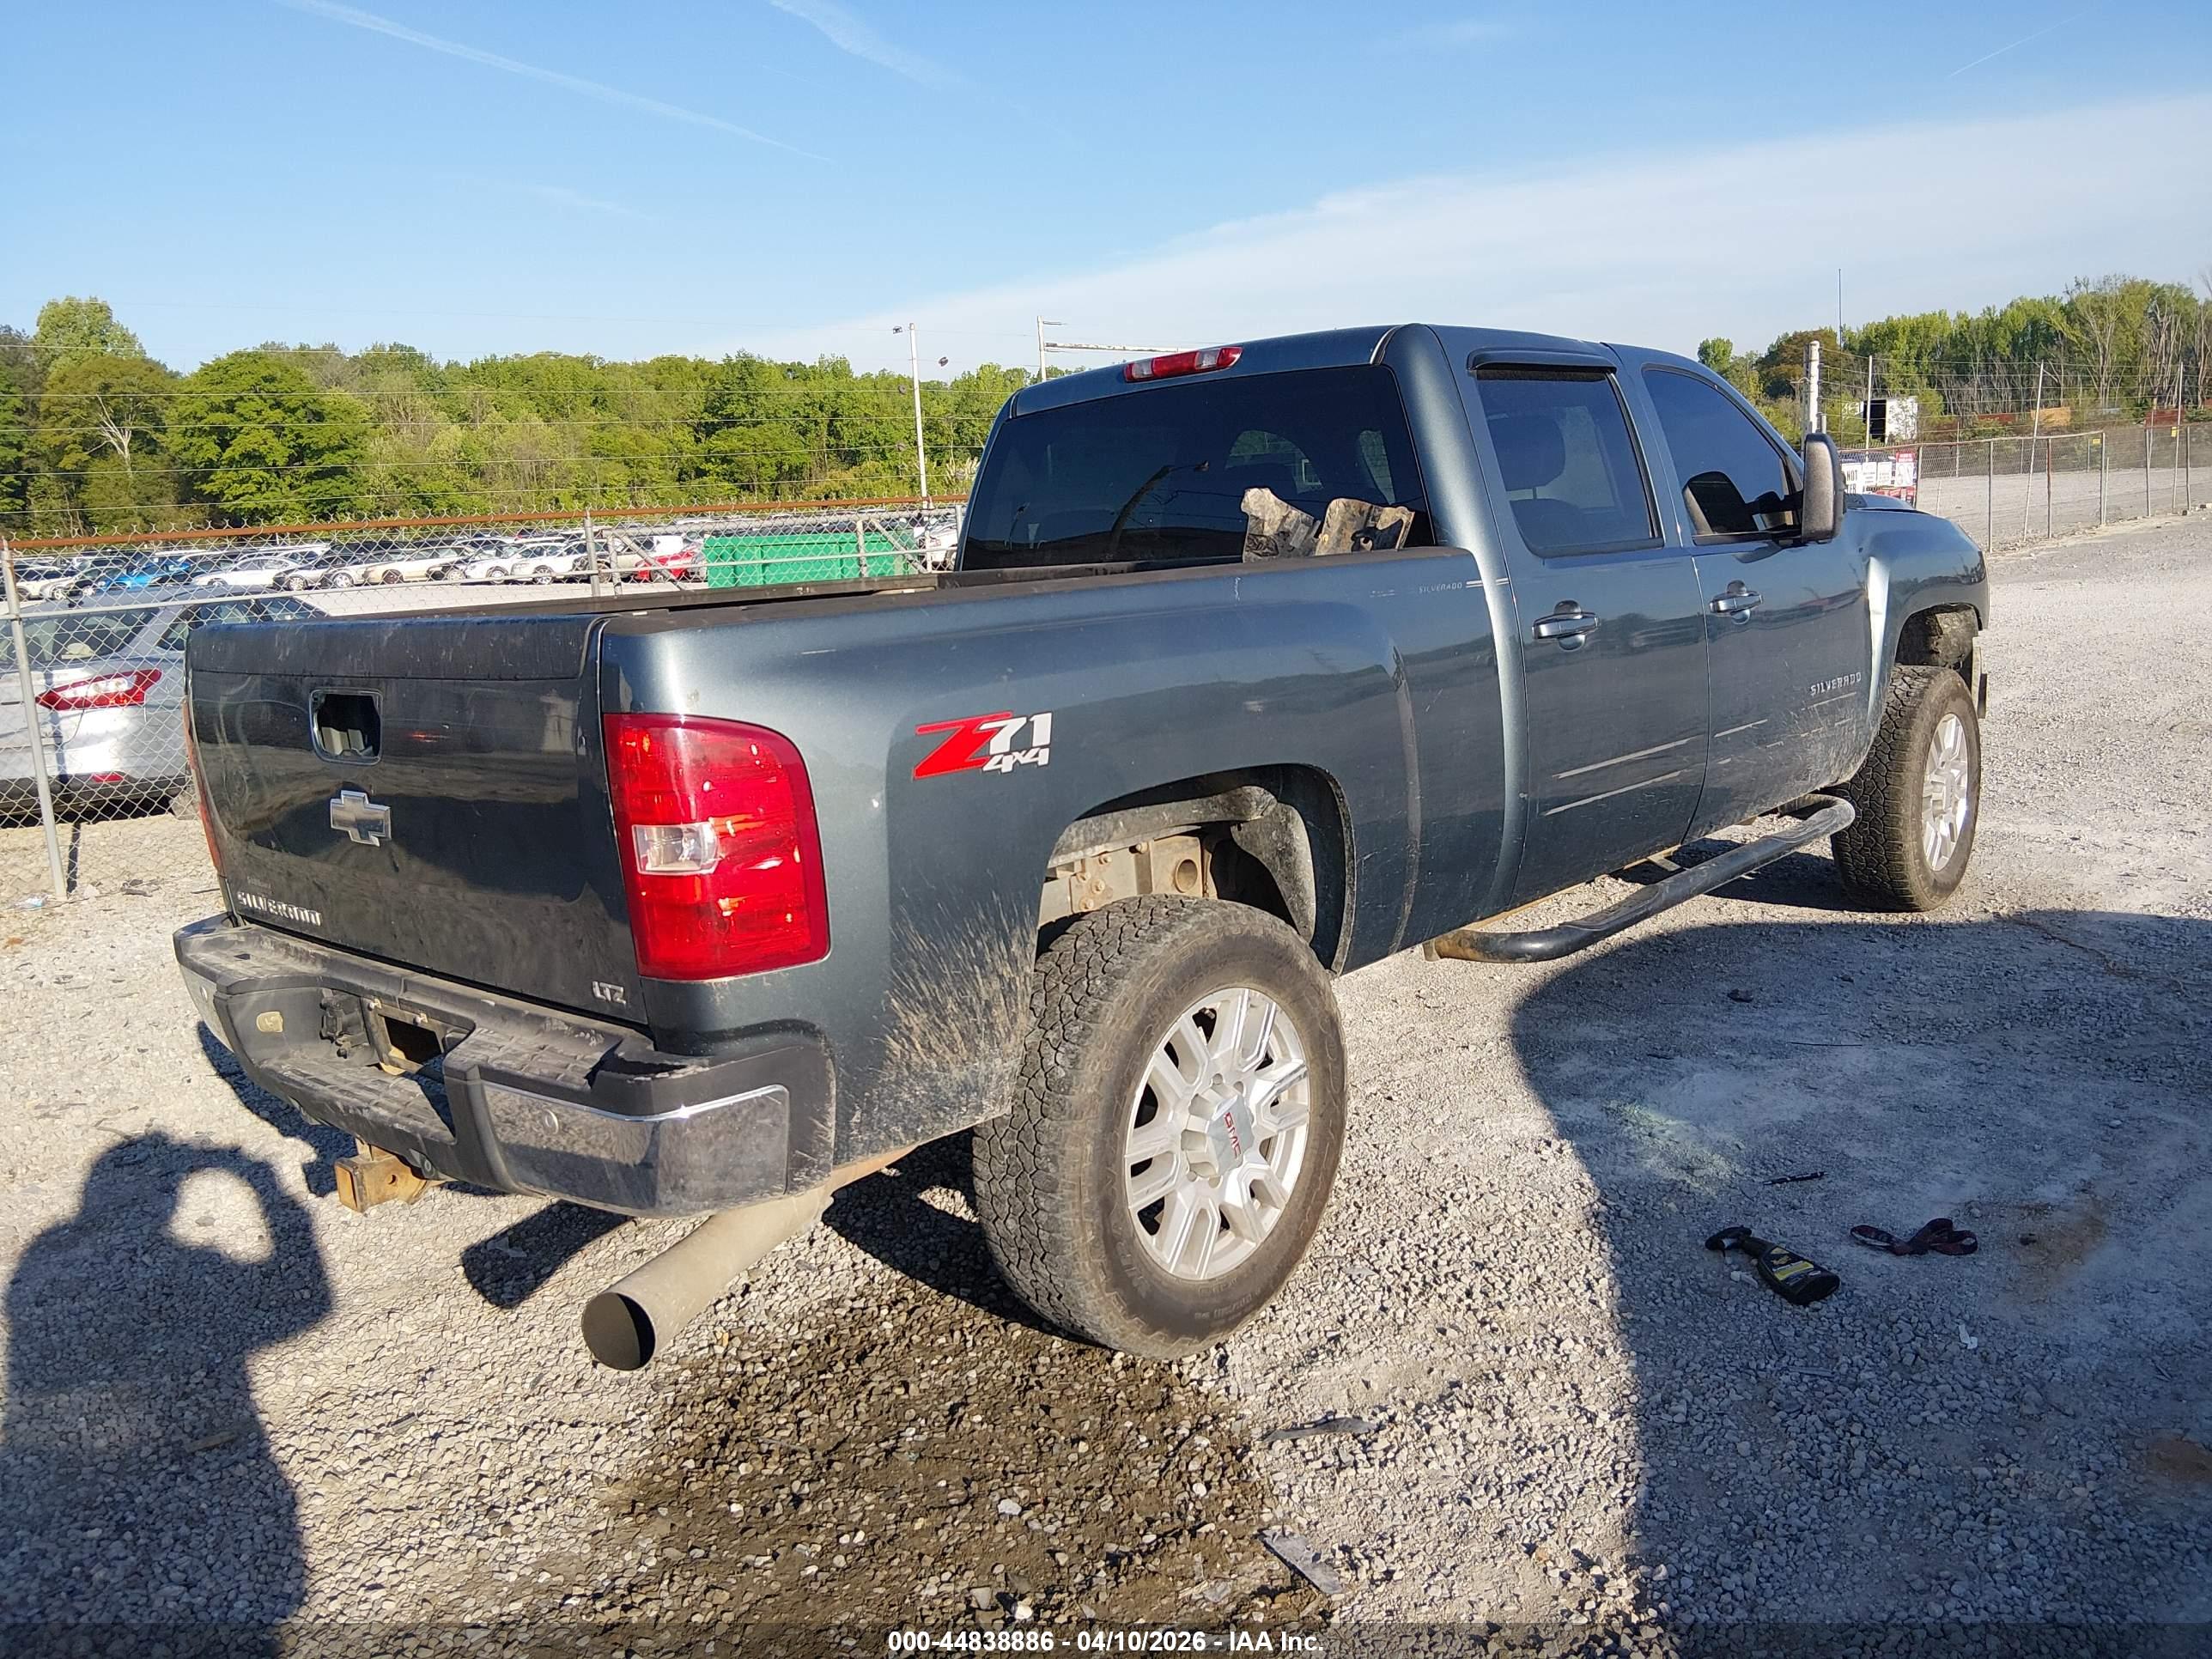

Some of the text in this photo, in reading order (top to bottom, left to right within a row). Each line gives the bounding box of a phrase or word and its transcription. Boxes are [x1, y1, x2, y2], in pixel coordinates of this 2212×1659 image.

[1810, 672, 1862, 697] SILVERADO
[912, 710, 1053, 780] Z71
[237, 891, 322, 927] SILVERADO
[592, 981, 627, 1005] LTZ
[1223, 1111, 1242, 1159] GMC
